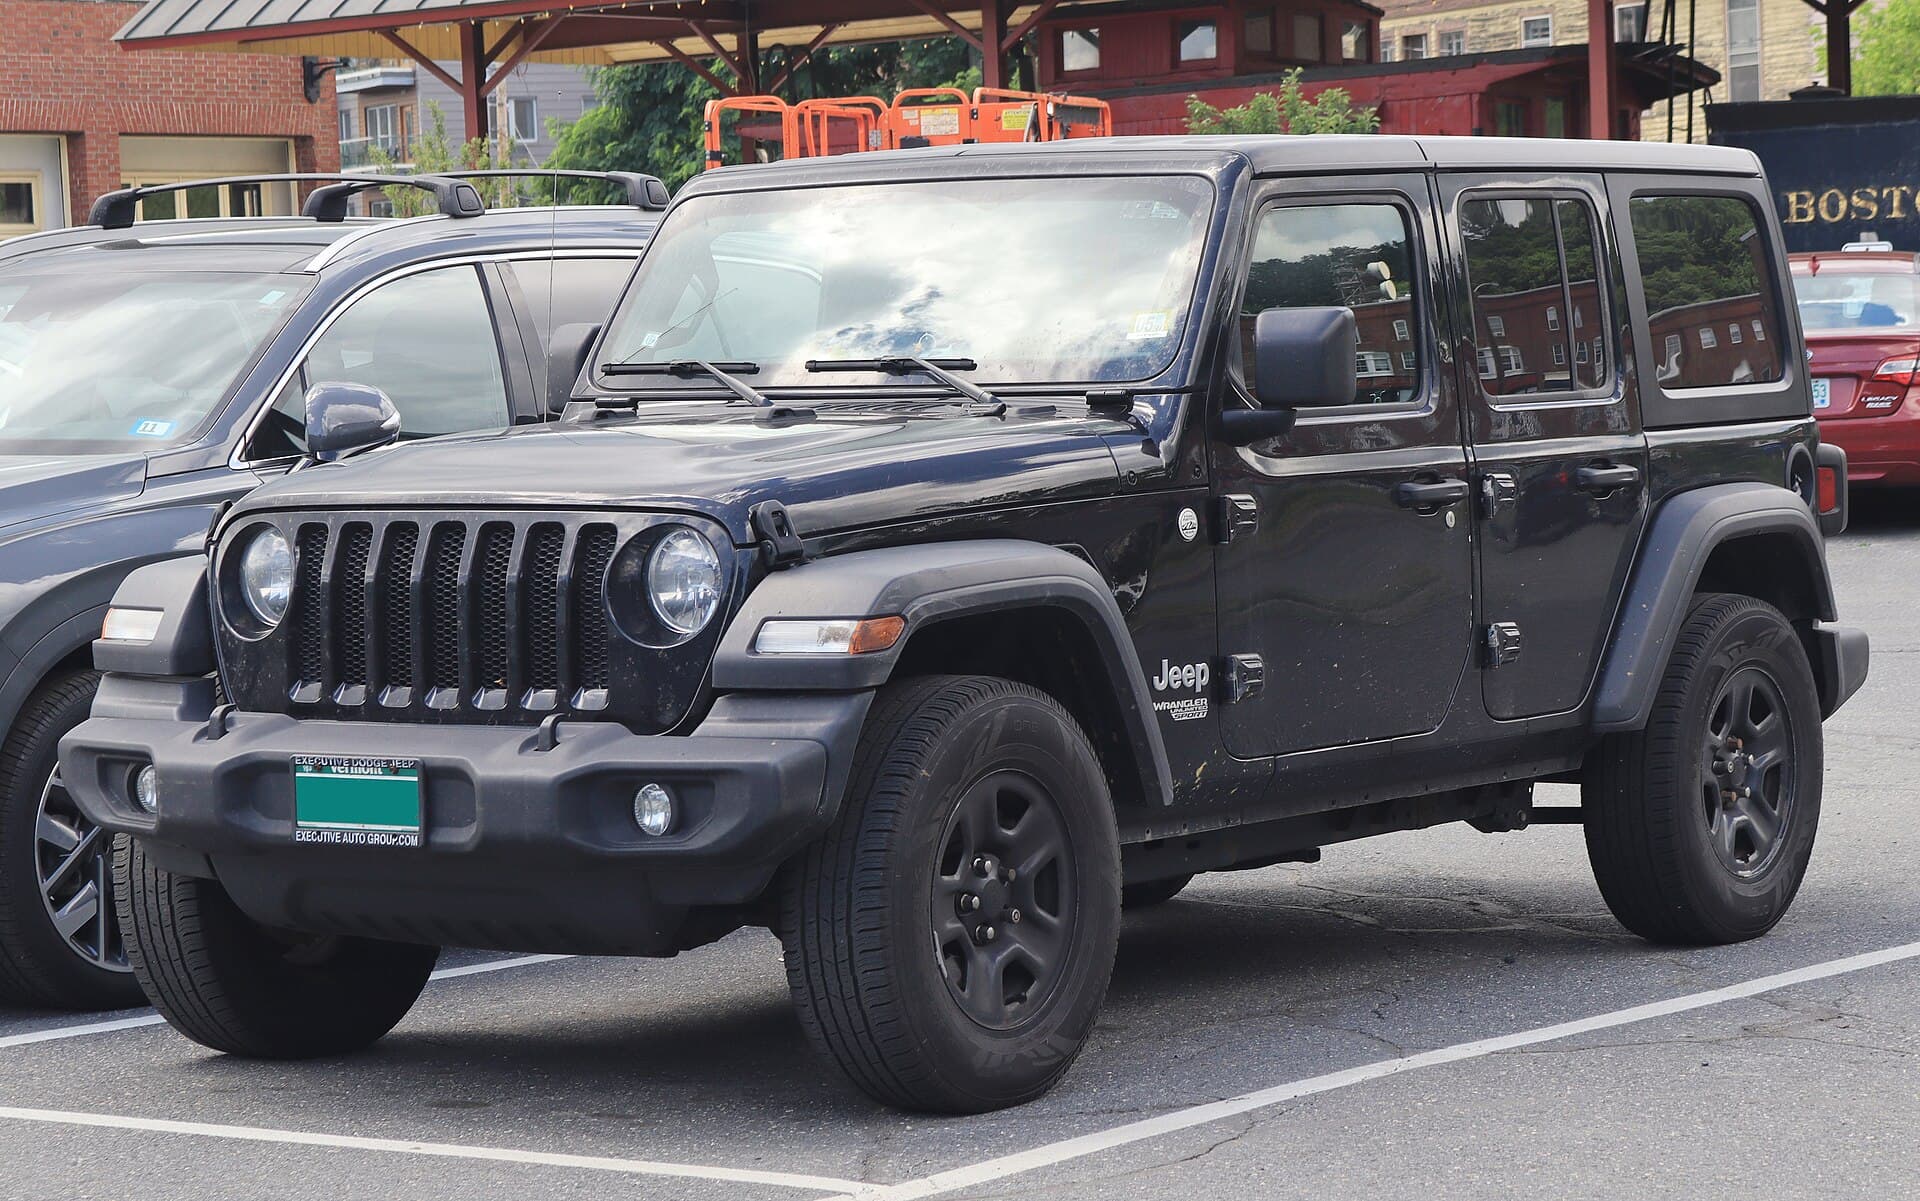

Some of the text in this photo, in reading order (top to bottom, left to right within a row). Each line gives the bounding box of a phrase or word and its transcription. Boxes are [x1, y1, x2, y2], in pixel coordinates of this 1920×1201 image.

[1783, 186, 1920, 223] BOST
[1153, 659, 1210, 693] Jeep
[1153, 698, 1208, 711] WRANGLER
[295, 757, 415, 768] EXECUTIVE DODGE JEEP
[295, 831, 418, 846] EXECUTIVE AUTO GROUP.COM
